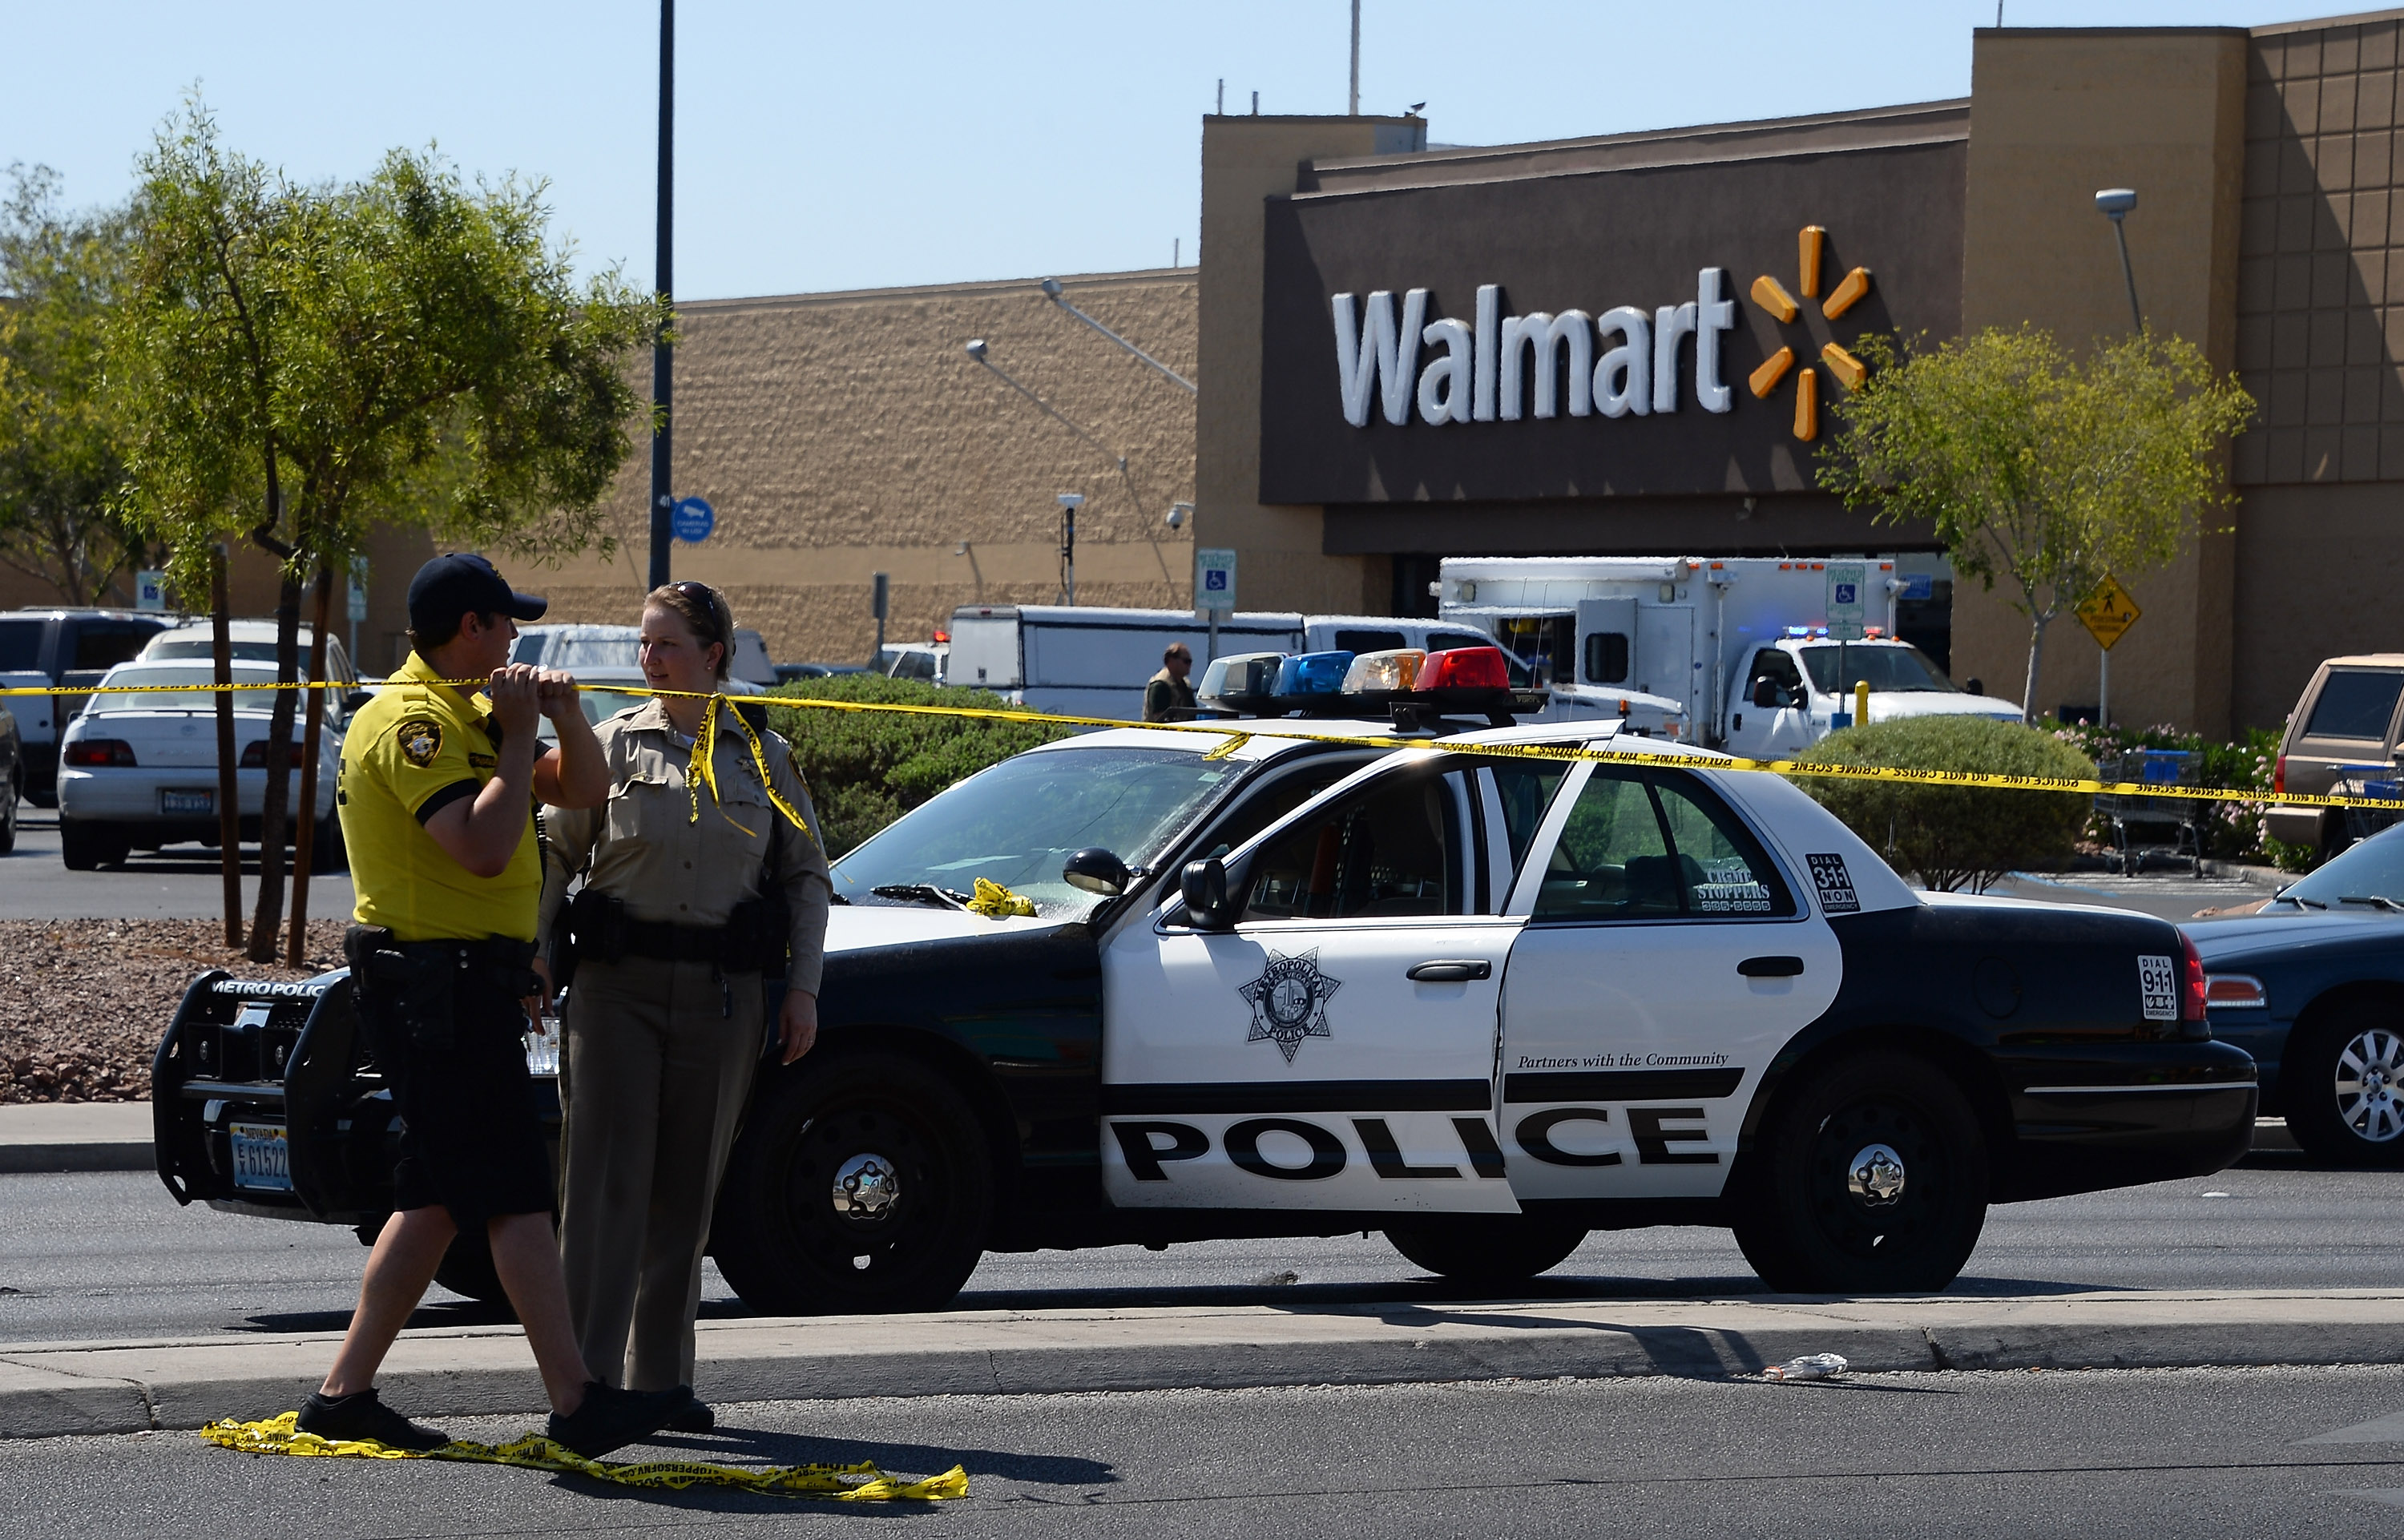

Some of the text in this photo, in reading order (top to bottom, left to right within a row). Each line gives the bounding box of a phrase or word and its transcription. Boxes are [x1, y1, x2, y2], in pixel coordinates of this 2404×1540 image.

[1331, 267, 1735, 428] Walmart
[1810, 857, 1839, 865] DIAL
[1697, 884, 1770, 899] STOPPERS
[1821, 889, 1855, 903] NON
[2142, 958, 2168, 968] DIAL
[211, 980, 271, 995] METRO
[1255, 960, 1324, 1002] METROPOLITAN
[1269, 971, 1311, 990] LAS VEGAS
[1267, 1022, 1310, 1040] POLICE
[1518, 1051, 1729, 1069] Partners with the Community
[245, 1127, 275, 1141] NEVADA
[1109, 1107, 1720, 1182] POLICE
[248, 1145, 288, 1179] 61522
